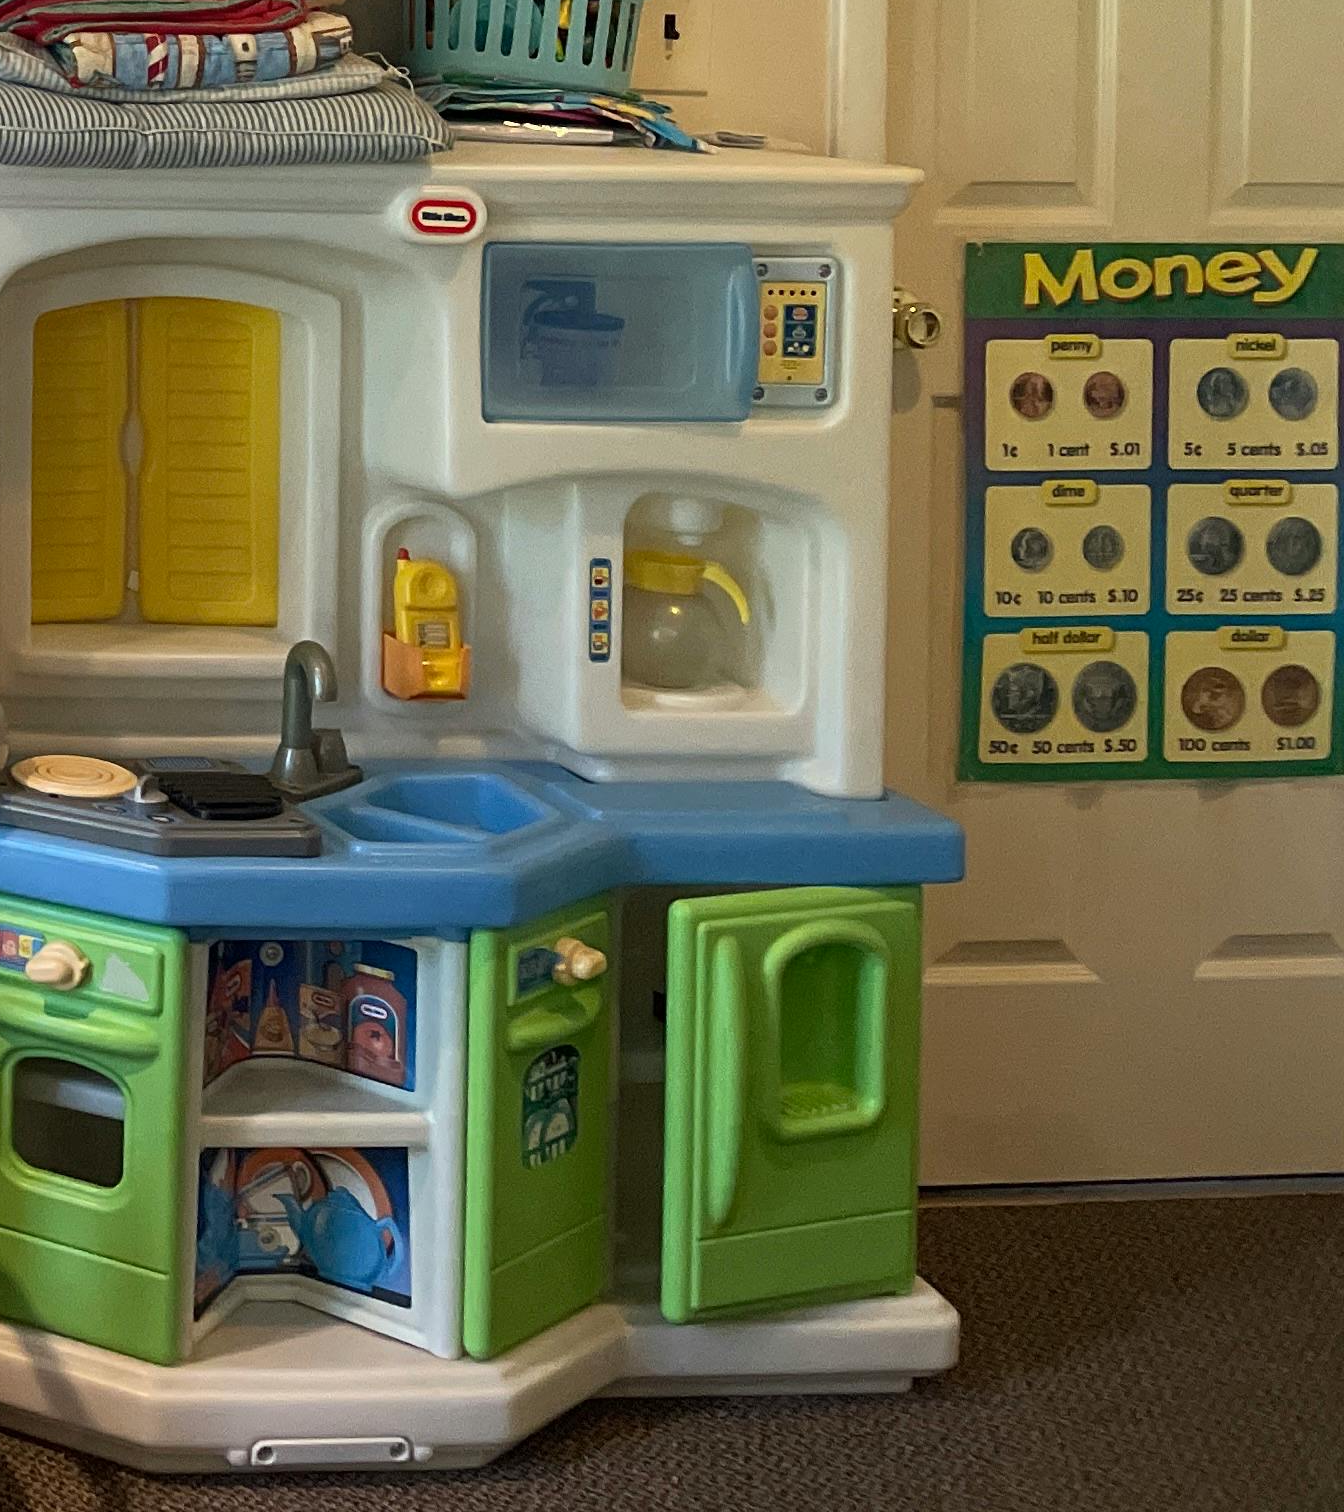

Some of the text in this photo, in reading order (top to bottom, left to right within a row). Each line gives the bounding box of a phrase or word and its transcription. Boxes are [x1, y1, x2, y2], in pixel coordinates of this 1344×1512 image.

[1023, 248, 1319, 310] Money
[1051, 339, 1094, 354] penny
[1236, 339, 1276, 352] nickel
[1059, 444, 1090, 457] cent
[1241, 444, 1281, 457] cents
[1052, 484, 1085, 498] dime
[1229, 485, 1285, 499] quarter
[1038, 591, 1053, 605] 10
[1058, 591, 1096, 604] cents
[1220, 589, 1238, 602] 25
[1242, 590, 1282, 603] cents
[1032, 631, 1102, 645] half dollar
[1231, 630, 1270, 643] dollar
[1032, 740, 1053, 754] 50
[1056, 740, 1095, 754] cents
[1211, 739, 1251, 752] cents
